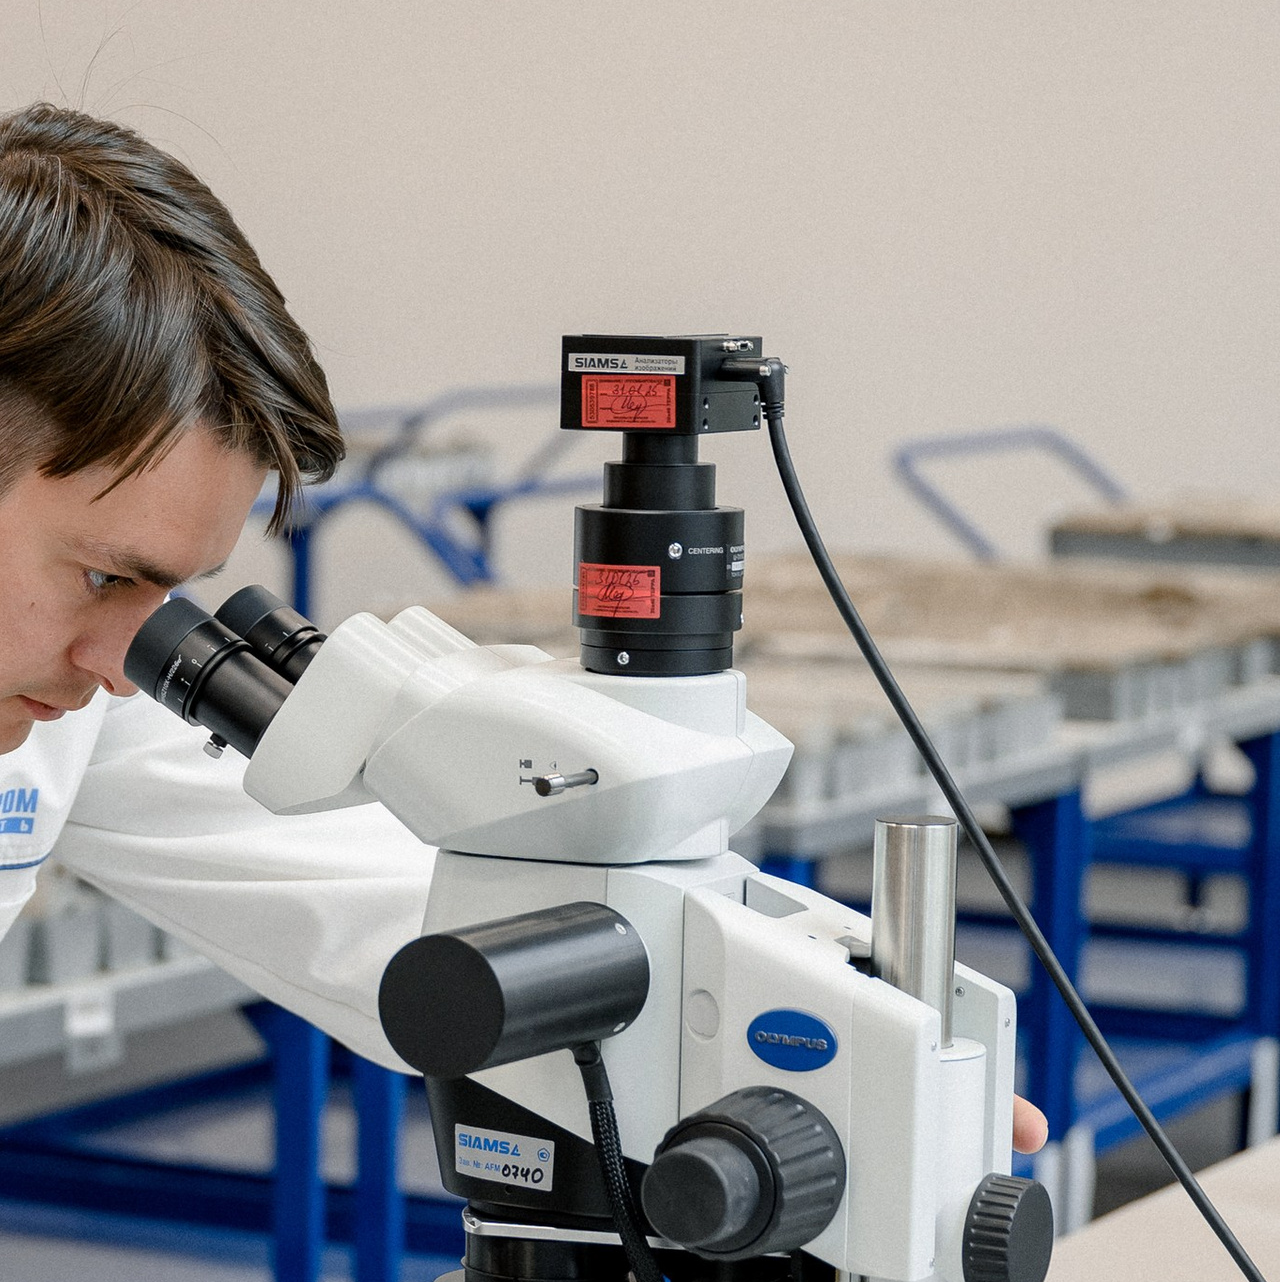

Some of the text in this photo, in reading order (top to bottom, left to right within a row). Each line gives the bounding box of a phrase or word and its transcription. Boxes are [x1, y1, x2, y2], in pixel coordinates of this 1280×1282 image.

[575, 357, 619, 369] SIAMS
[755, 1031, 828, 1050] OLYMPUS
[458, 1133, 510, 1155] SIAMS
[501, 1163, 544, 1184] 0740
